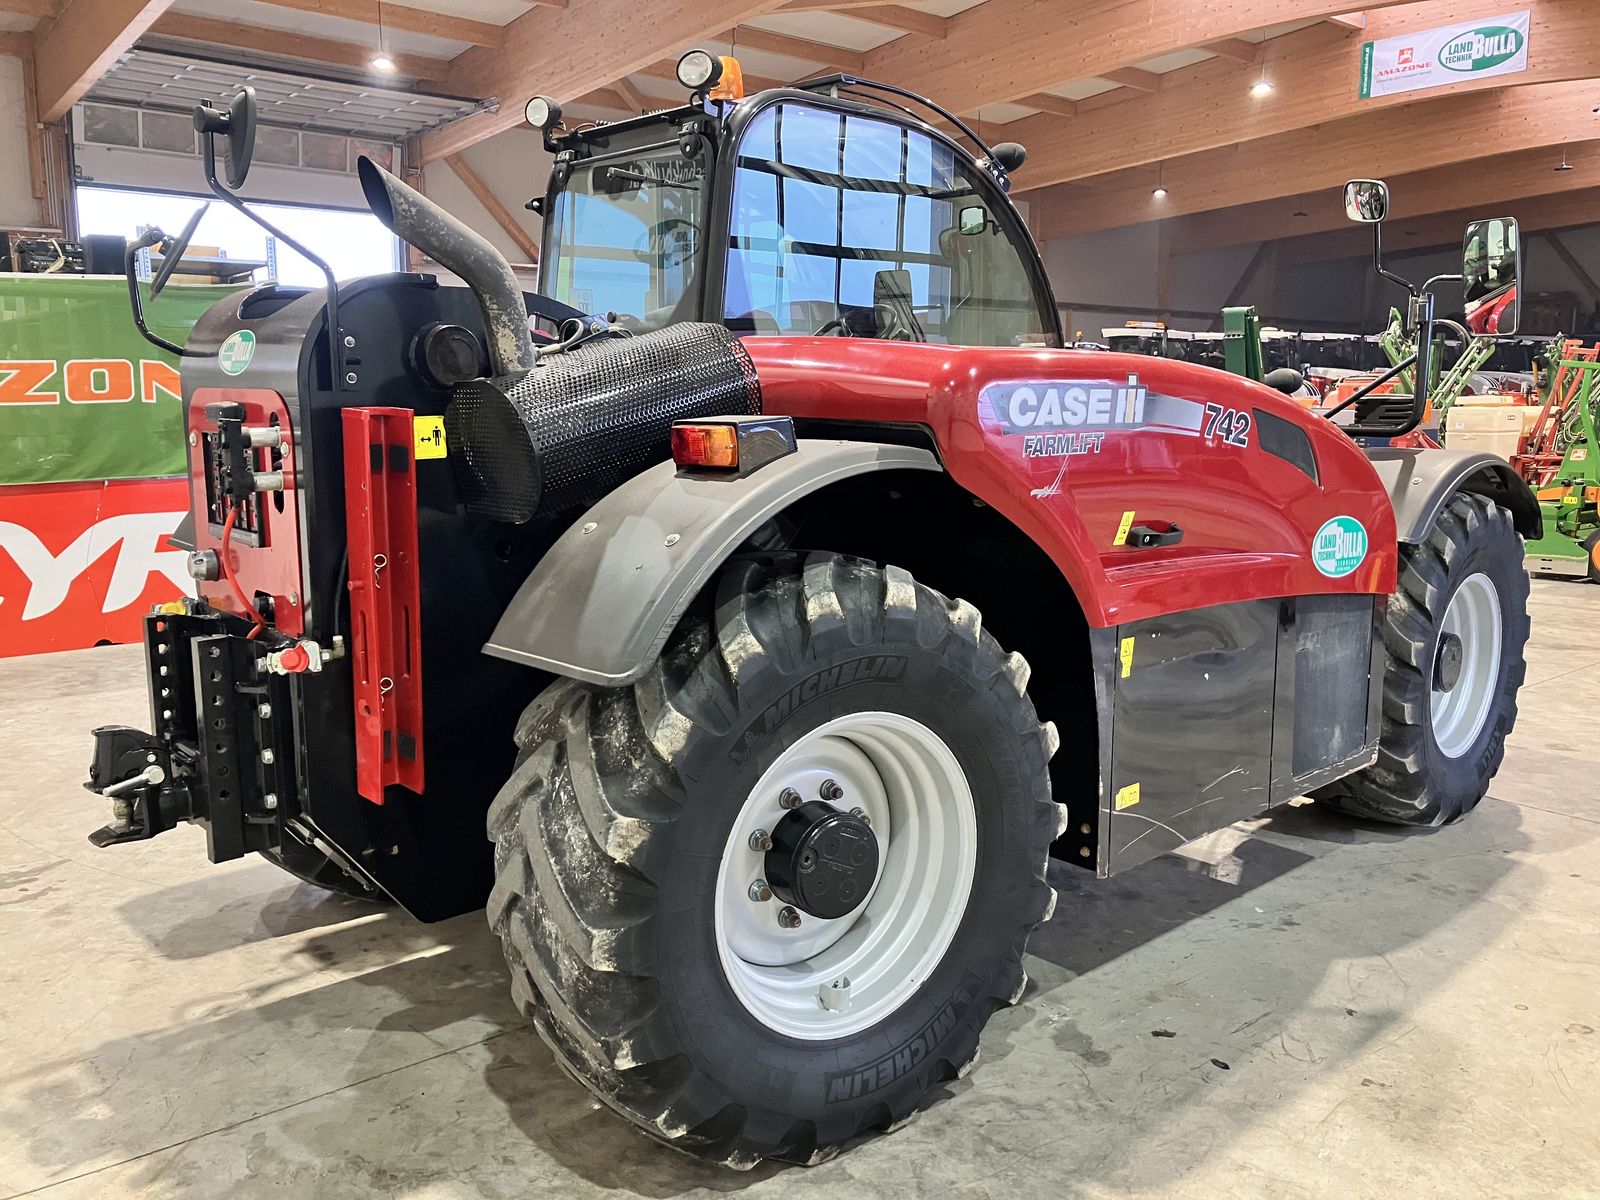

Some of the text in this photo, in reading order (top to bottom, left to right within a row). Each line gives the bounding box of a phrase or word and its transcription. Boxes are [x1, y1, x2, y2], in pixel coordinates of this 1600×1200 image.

[1445, 53, 1473, 65] TECHNIK
[1448, 41, 1474, 56] LAND
[1475, 32, 1517, 59] BULLA
[1376, 61, 1433, 77] AMAZONE
[1009, 387, 1113, 427] CASE
[1203, 401, 1252, 447] 742
[1022, 432, 1105, 458] FARMLIFT
[1319, 533, 1337, 550] LAND
[1335, 526, 1363, 560] BULLA
[764, 655, 908, 735] MICHELIN
[828, 1003, 958, 1103] MICHELIN
